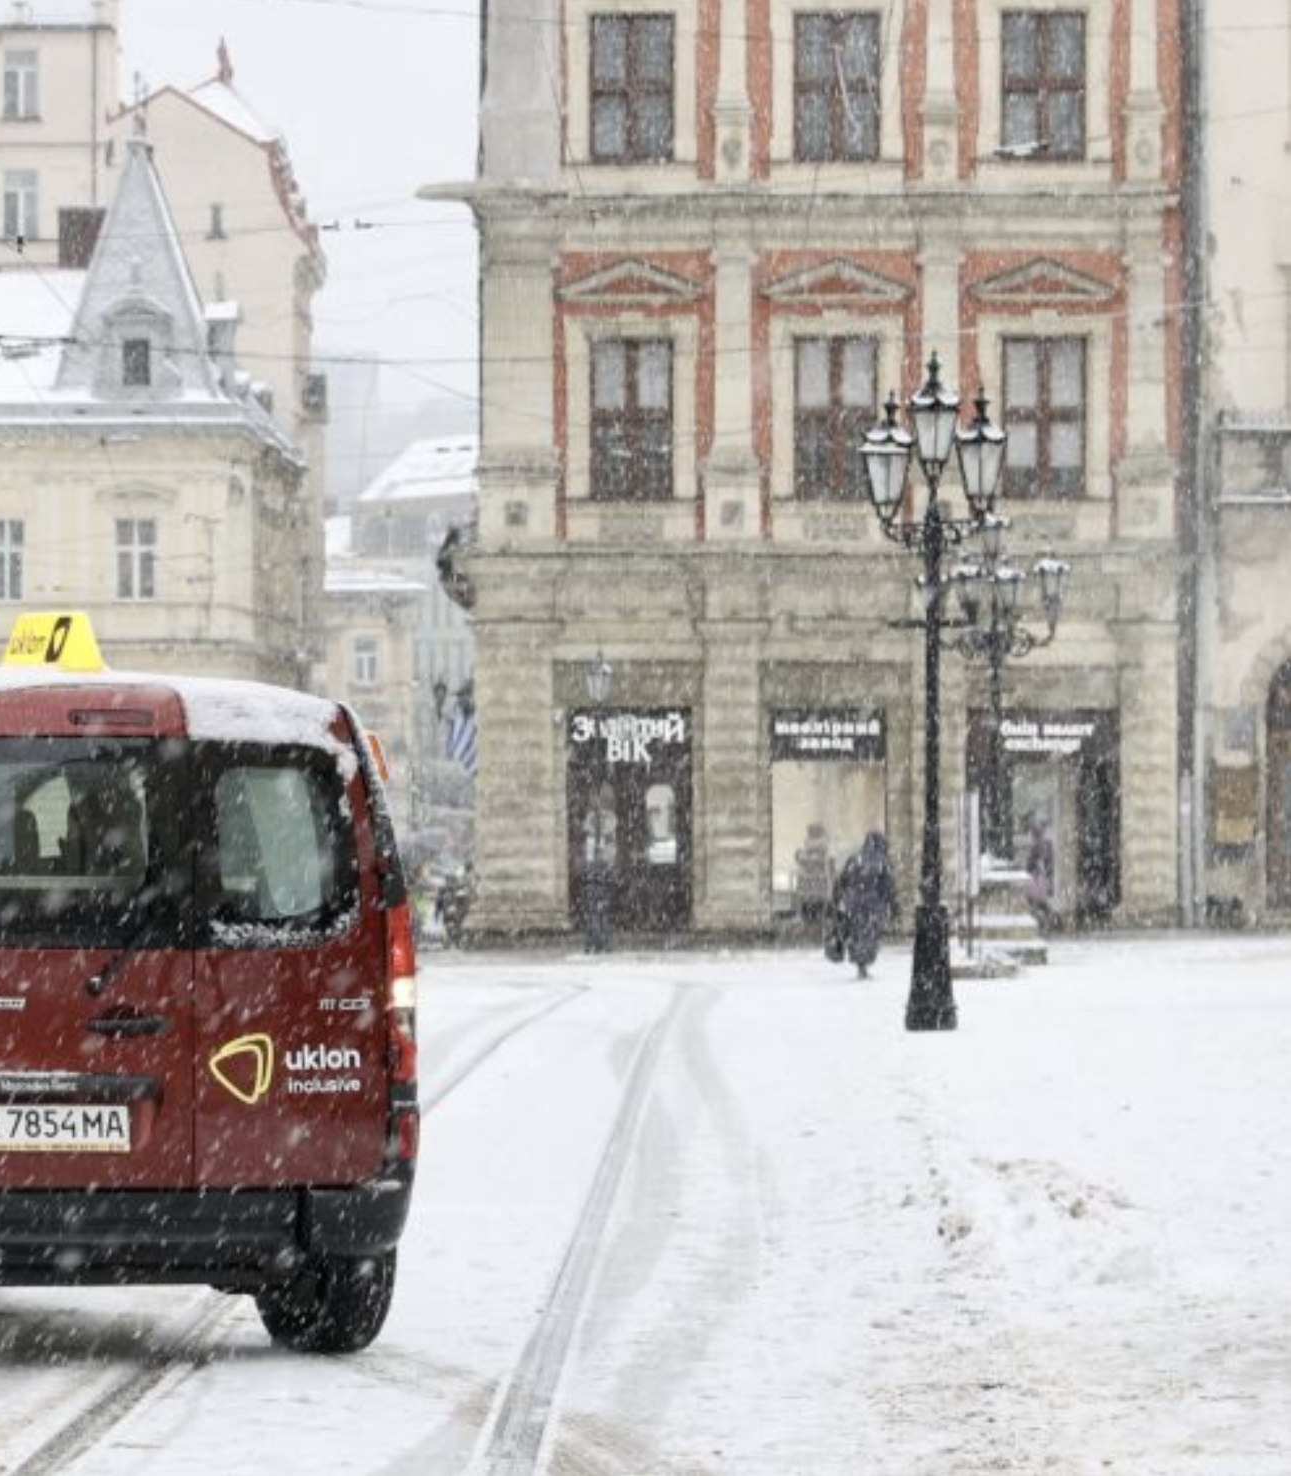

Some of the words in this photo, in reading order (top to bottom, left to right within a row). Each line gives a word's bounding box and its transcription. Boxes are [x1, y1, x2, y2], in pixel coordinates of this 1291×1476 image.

[285, 1043, 361, 1071] uklon
[287, 1077, 361, 1094] inclusive
[6, 1110, 77, 1139] 7854
[81, 1110, 125, 1139] MA
